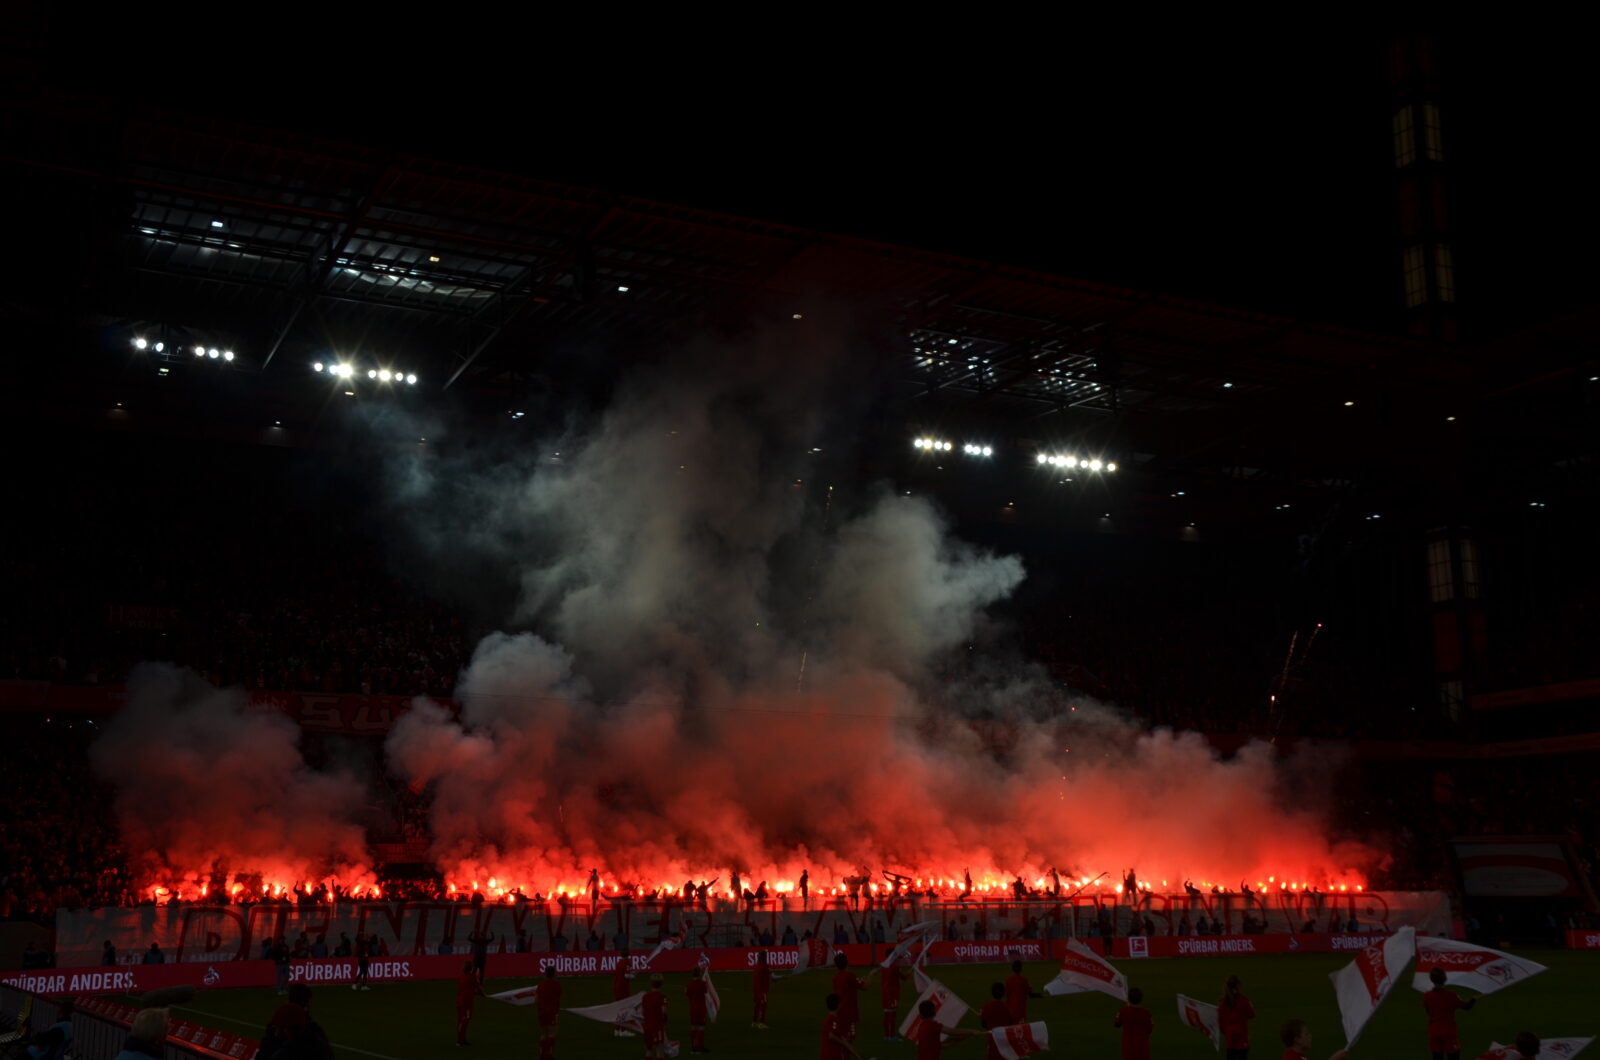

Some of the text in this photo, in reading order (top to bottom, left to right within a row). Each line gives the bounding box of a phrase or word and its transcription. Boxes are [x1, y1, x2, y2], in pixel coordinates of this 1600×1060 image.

[177, 905, 331, 963] DIE
[358, 902, 713, 957] NUMMER
[1178, 938, 1257, 954] SPÜRBAR ANDERS.
[69, 971, 138, 992] ANDERS.
[288, 961, 352, 982] SPÜRBAR
